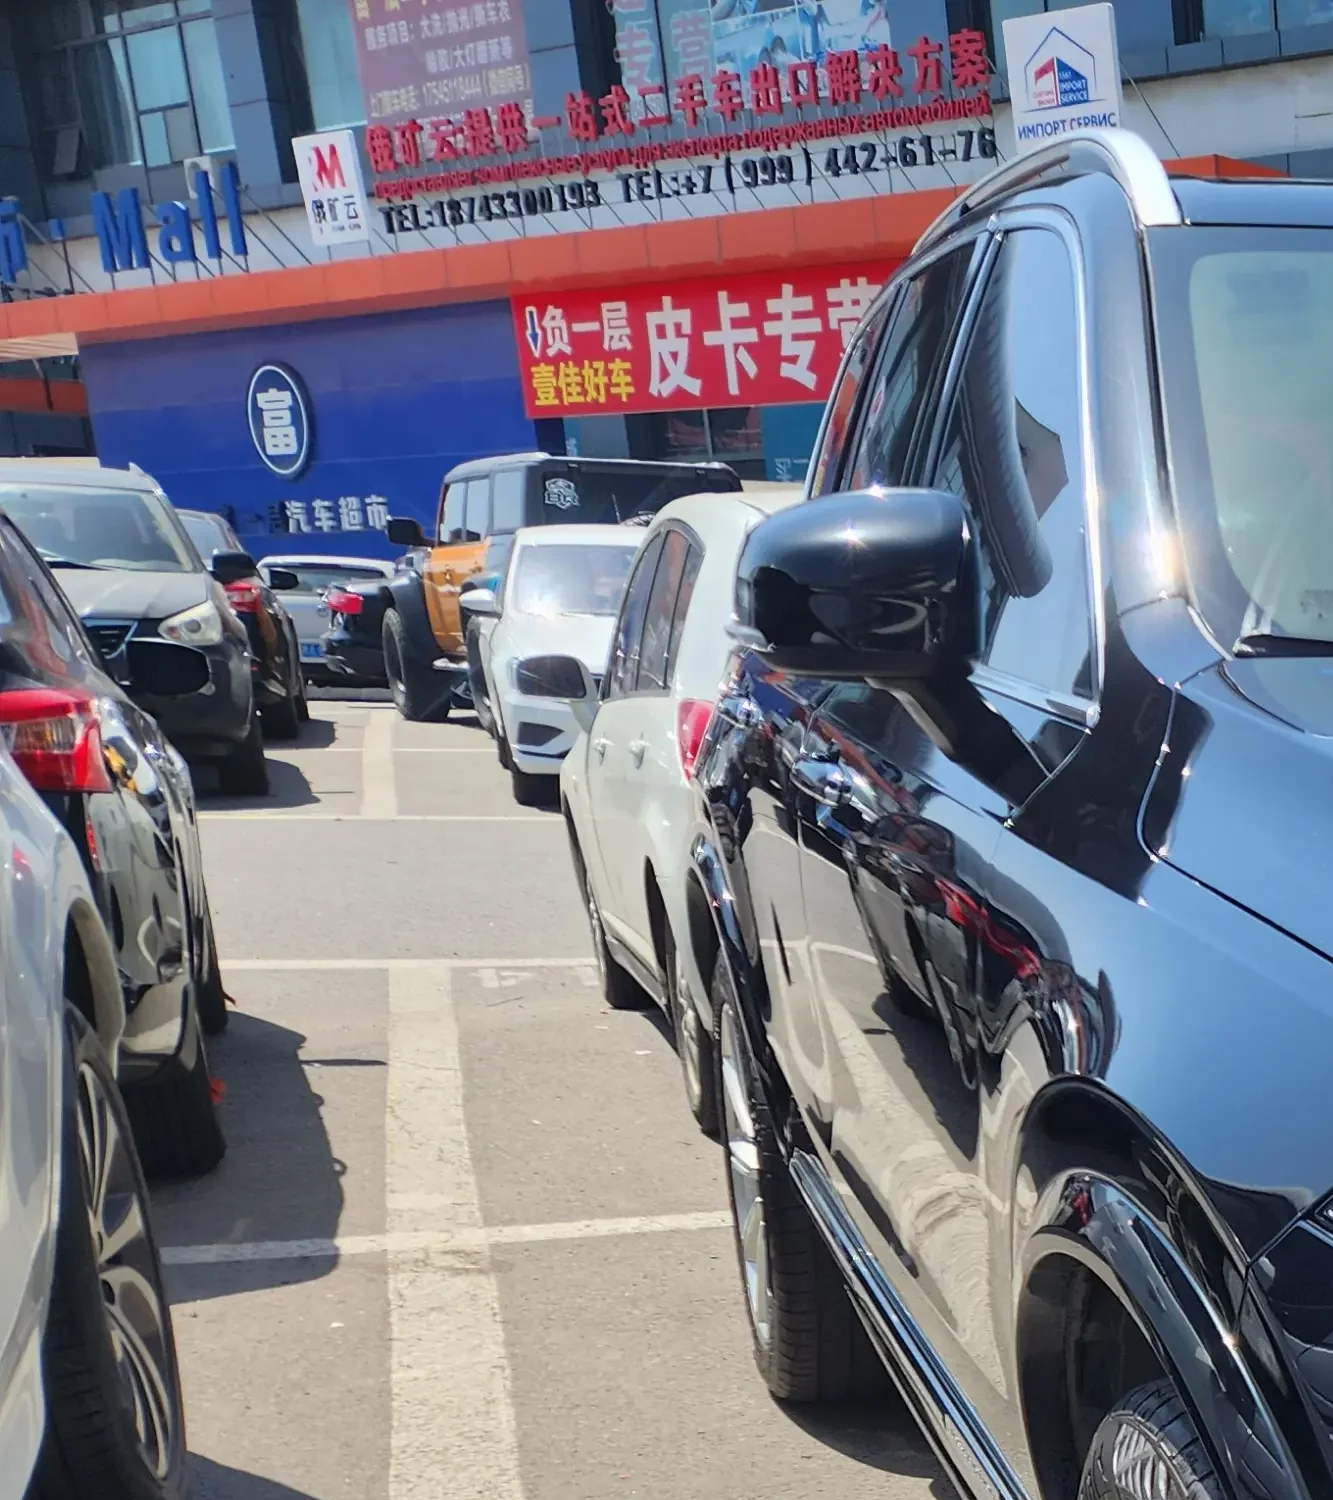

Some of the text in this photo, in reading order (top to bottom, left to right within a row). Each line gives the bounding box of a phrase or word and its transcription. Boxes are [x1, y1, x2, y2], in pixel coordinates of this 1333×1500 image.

[1017, 119, 1068, 141] ИМПОРТ
[92, 160, 249, 274] Mall
[541, 300, 633, 358] 负一层
[530, 358, 636, 407] 壹佳好车
[256, 387, 298, 457] 富
[284, 494, 388, 534] 汽车超市
